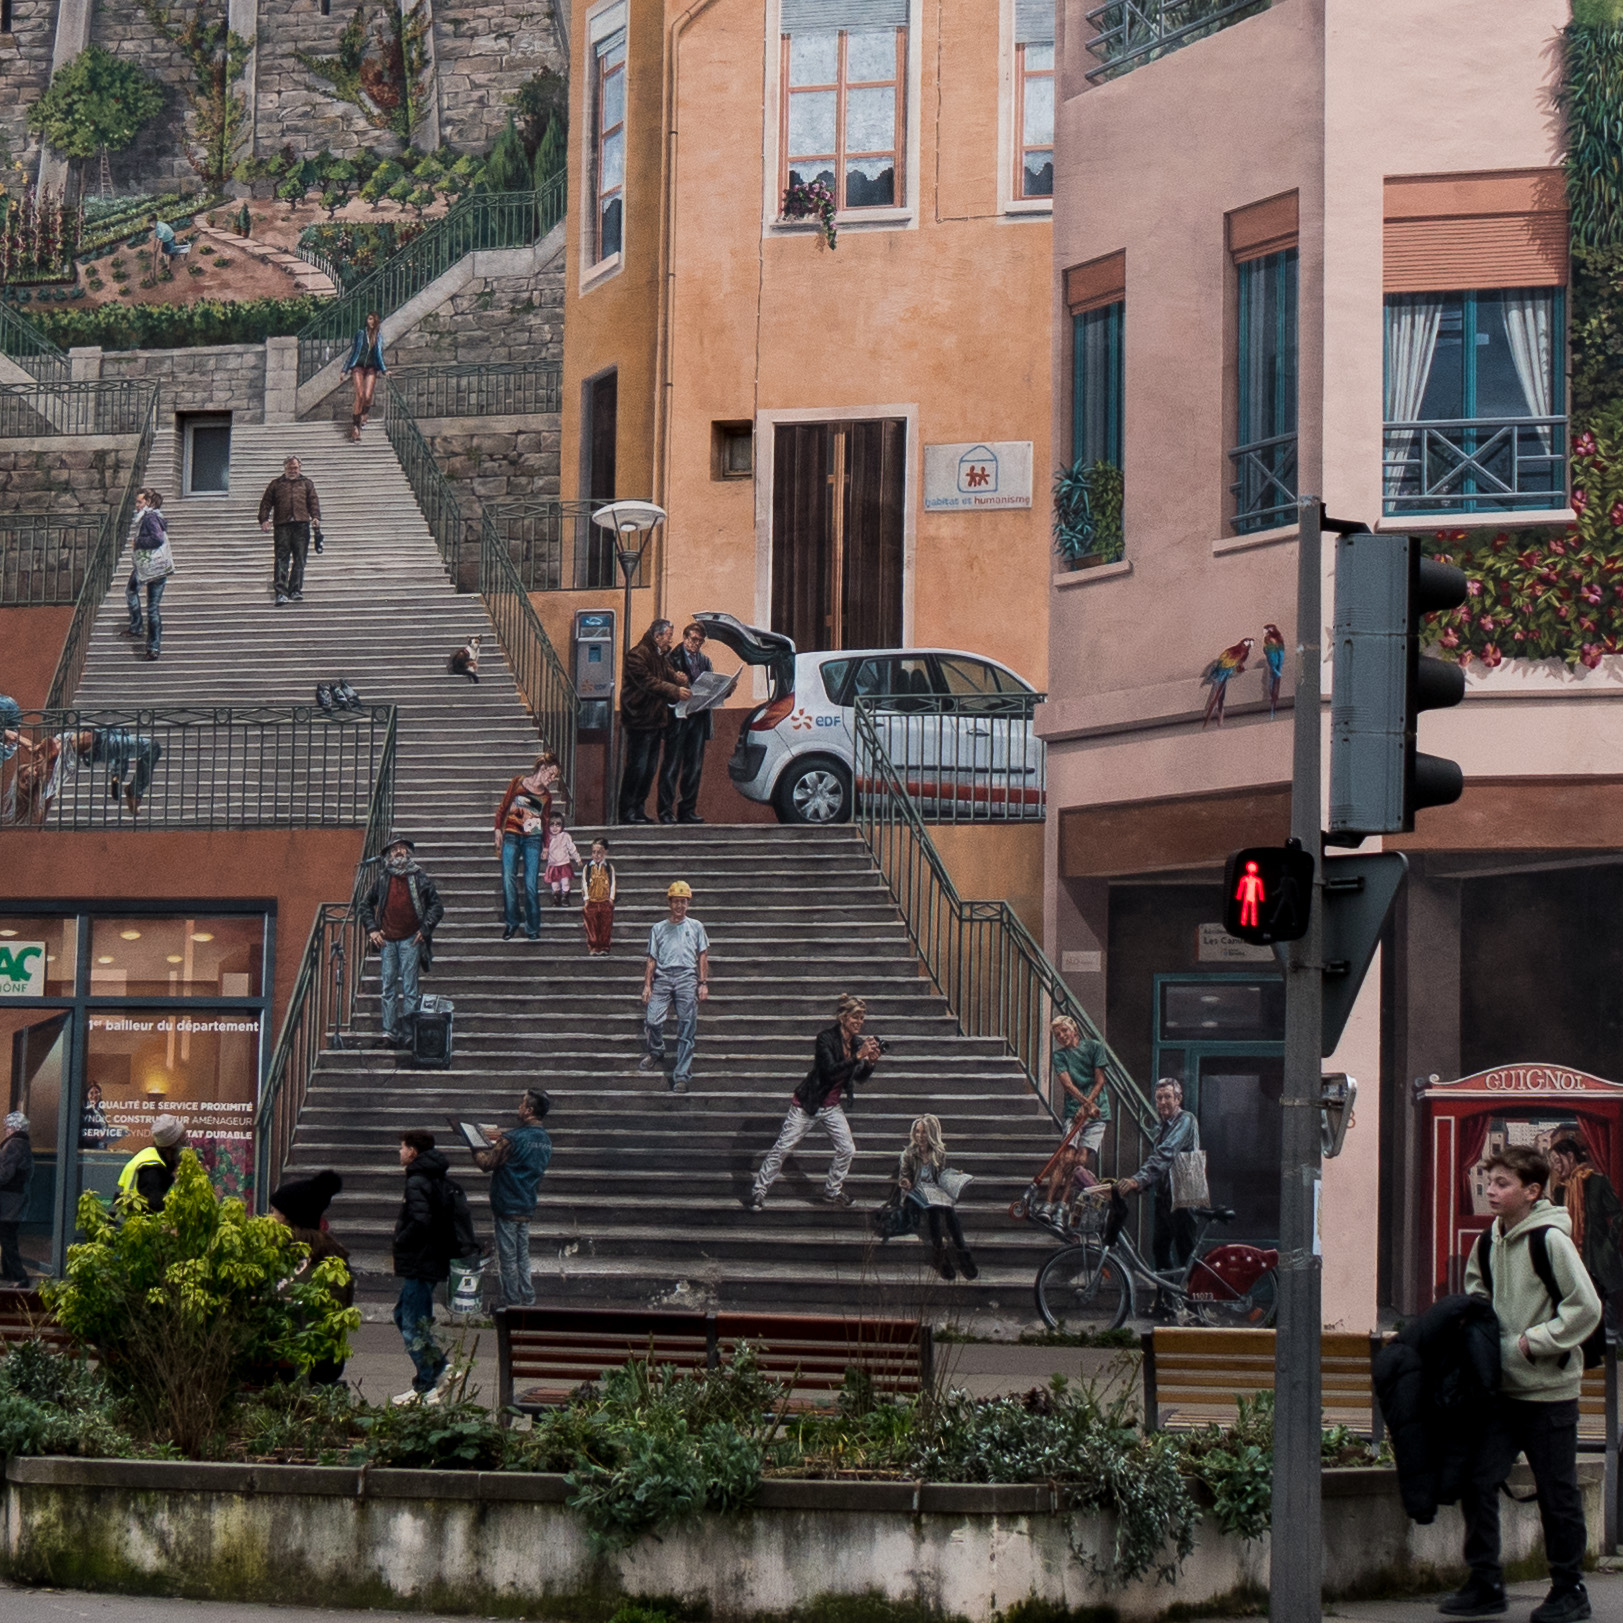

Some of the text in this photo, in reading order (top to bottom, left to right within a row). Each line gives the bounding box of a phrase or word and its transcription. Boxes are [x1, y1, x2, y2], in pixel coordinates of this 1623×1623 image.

[925, 494, 1031, 507] habitat et humanisme
[105, 1019, 154, 1032] bailleur
[157, 1020, 174, 1032] du
[176, 1019, 260, 1034] département
[1484, 1068, 1587, 1092] GUIGNOL
[98, 1099, 139, 1110] QUALITÉ
[142, 1101, 156, 1110] DE
[158, 1101, 199, 1111] SERVICE
[200, 1100, 254, 1112] PROXIMITÉ
[191, 1113, 253, 1126] AMÉNAGEUR
[205, 1129, 253, 1140] DURABLE
[1192, 1291, 1215, 1302] 11073
